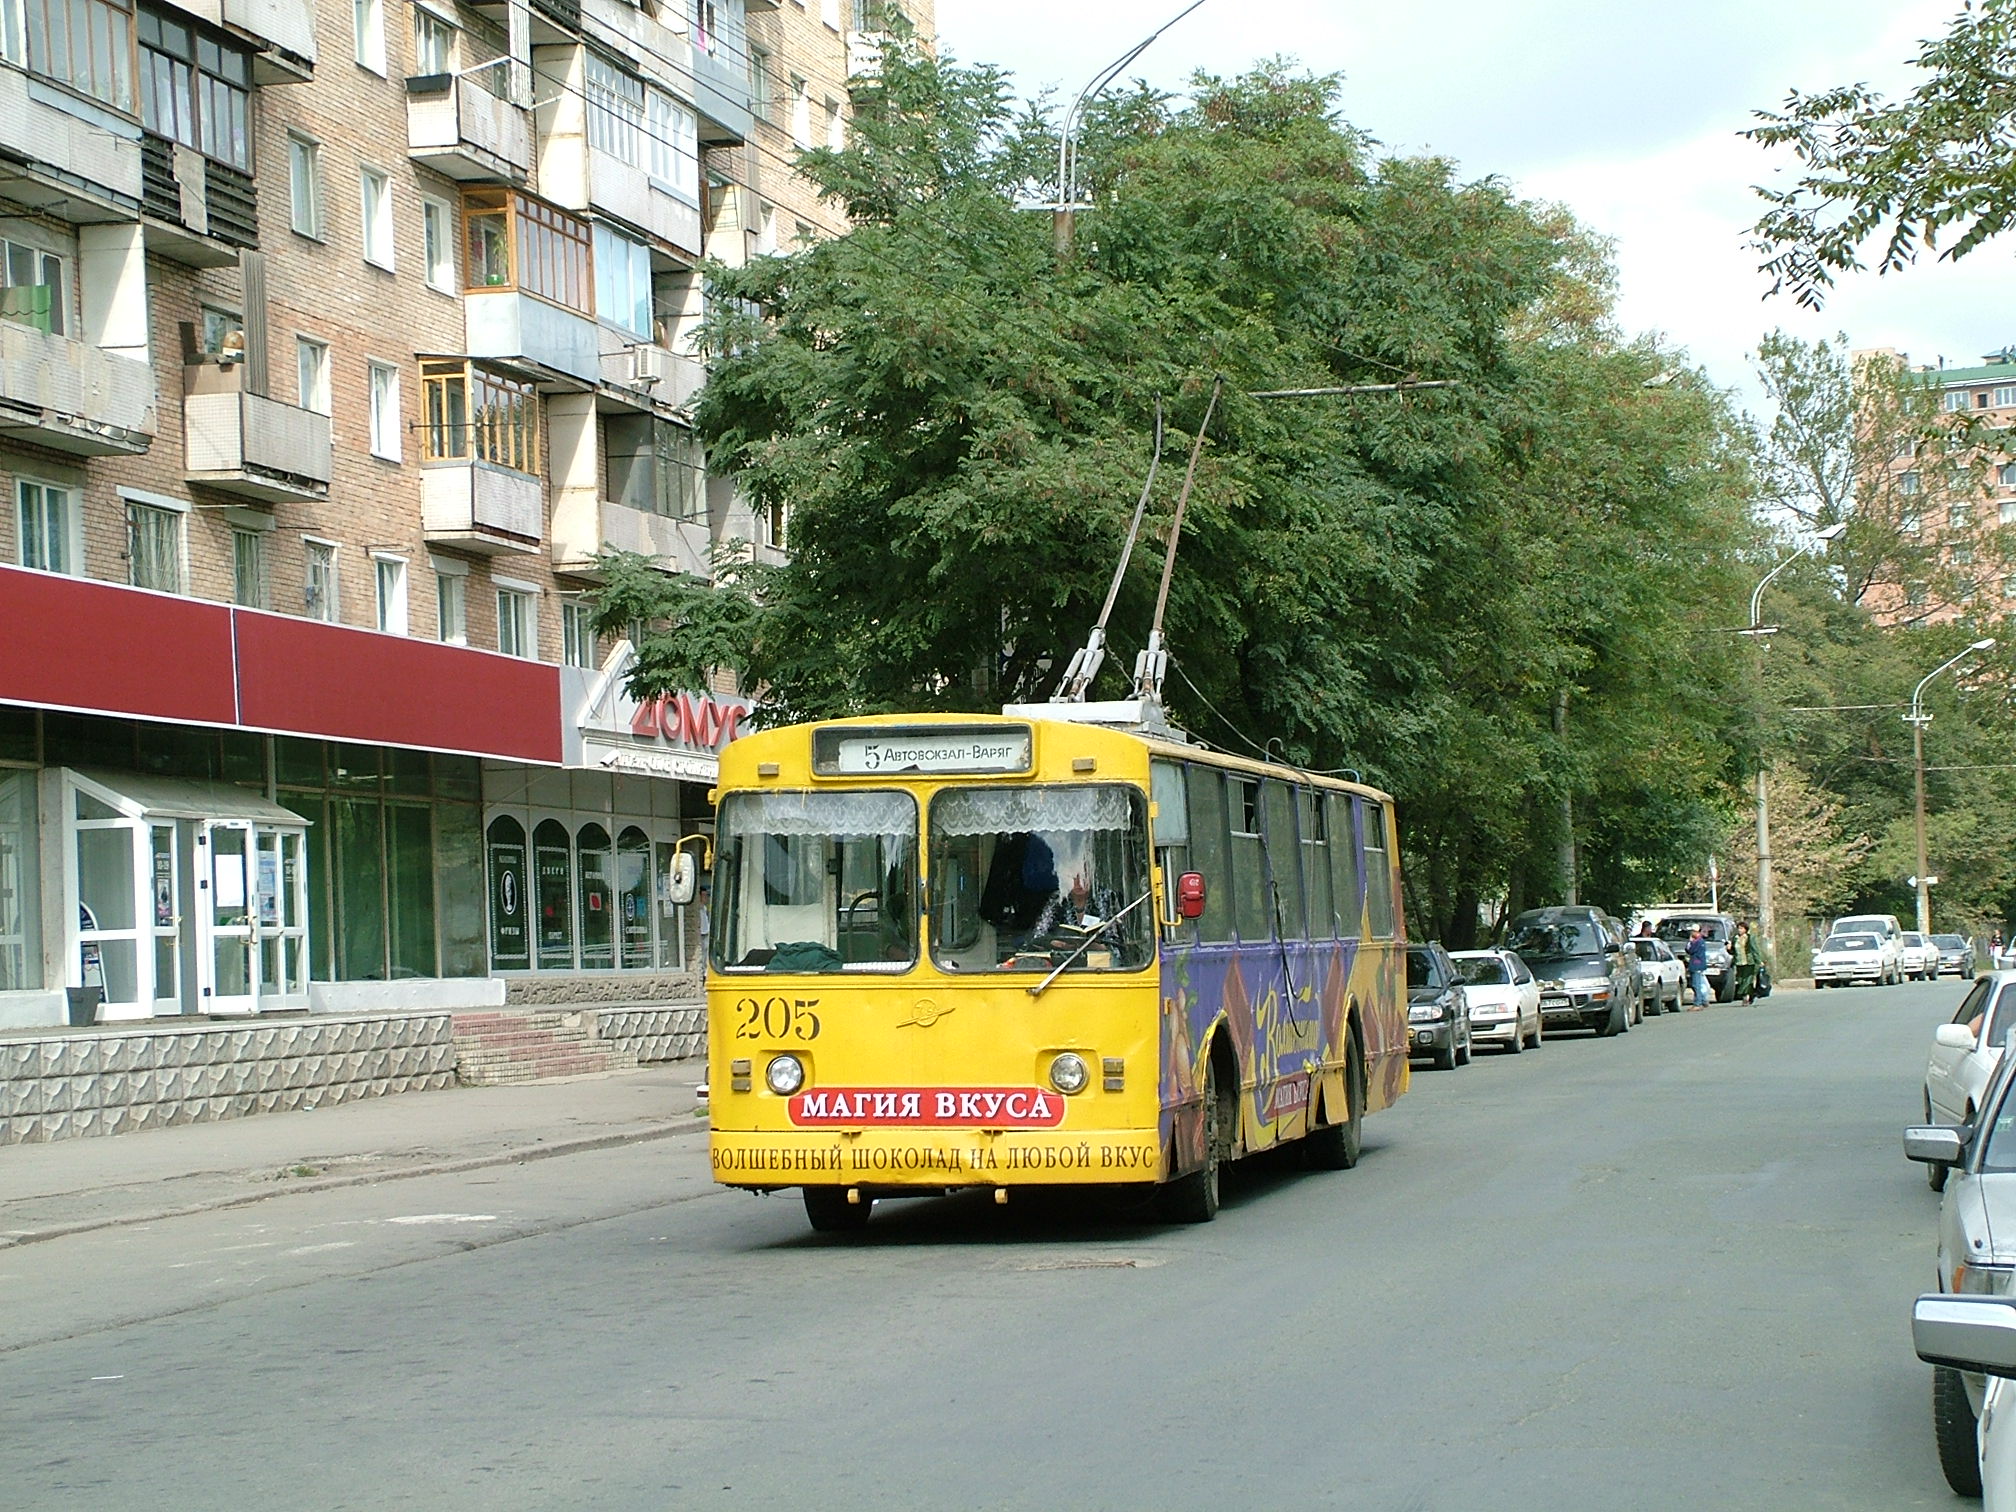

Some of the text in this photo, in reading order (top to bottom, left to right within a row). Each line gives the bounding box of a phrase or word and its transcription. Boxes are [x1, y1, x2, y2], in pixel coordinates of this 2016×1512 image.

[864, 744, 881, 770] 5
[736, 996, 821, 1041] 205
[800, 1092, 1053, 1118] МАГИЯ ВКУСА
[712, 1142, 1154, 1174] ВОЛШЕБНЫЙ ШОКОЛАД НА ЛЮБОЙ ВКУС
